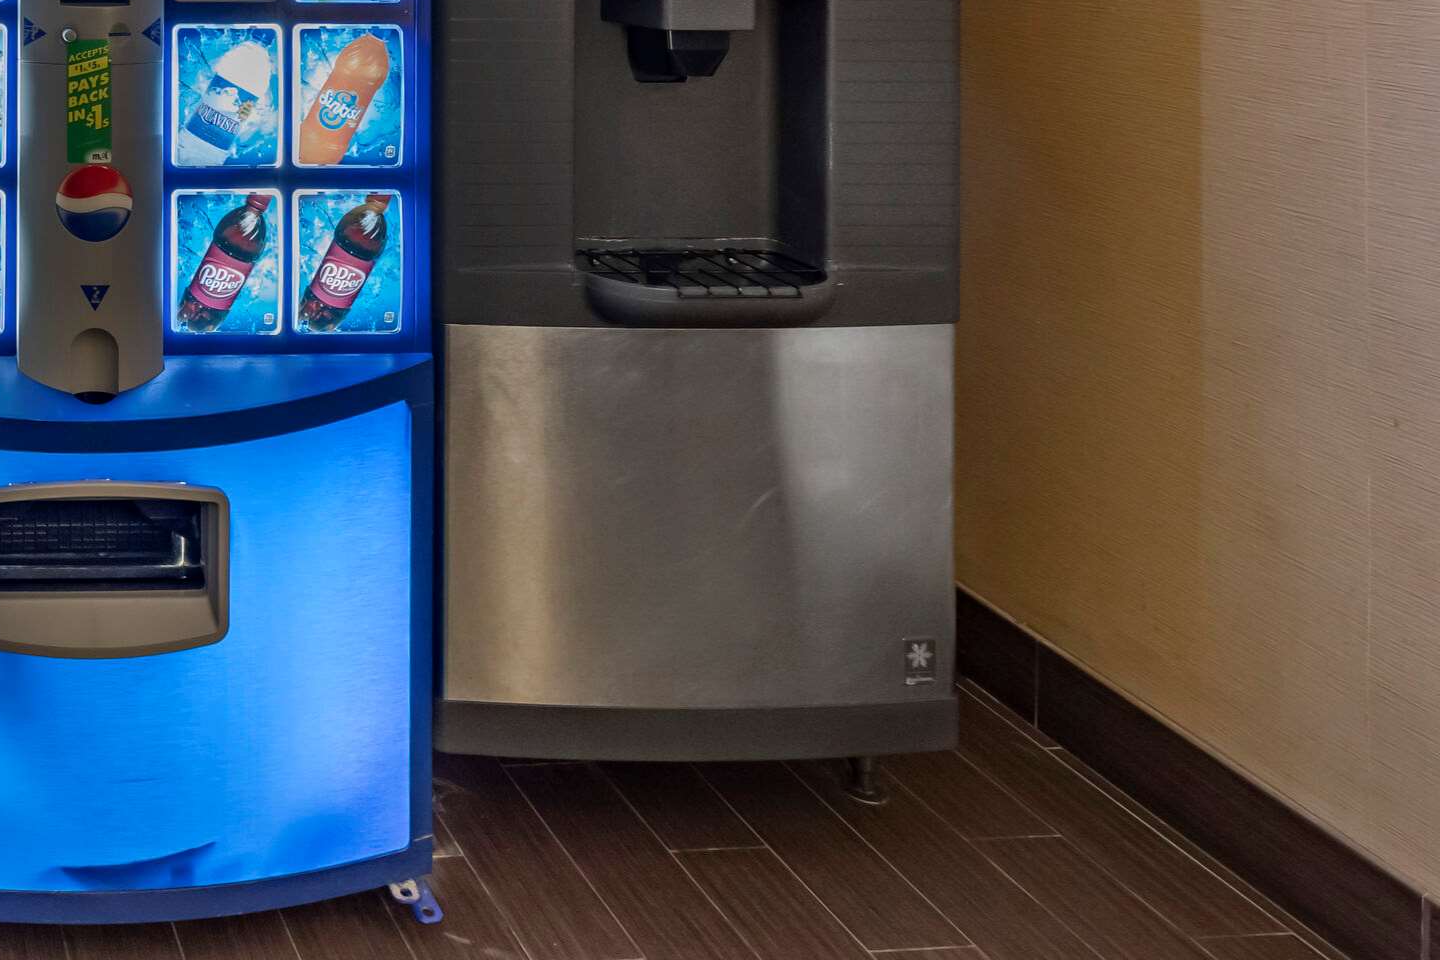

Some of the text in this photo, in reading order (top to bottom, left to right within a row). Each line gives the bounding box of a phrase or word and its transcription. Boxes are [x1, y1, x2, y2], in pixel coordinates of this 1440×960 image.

[69, 45, 110, 62] ACCEPTS
[68, 72, 109, 93] PAYS
[68, 87, 109, 108] BACK
[68, 108, 85, 123] IN
[200, 264, 242, 292] Pepper
[216, 270, 234, 282] Dr
[321, 263, 362, 290] Pepper
[336, 269, 355, 281] Dr
